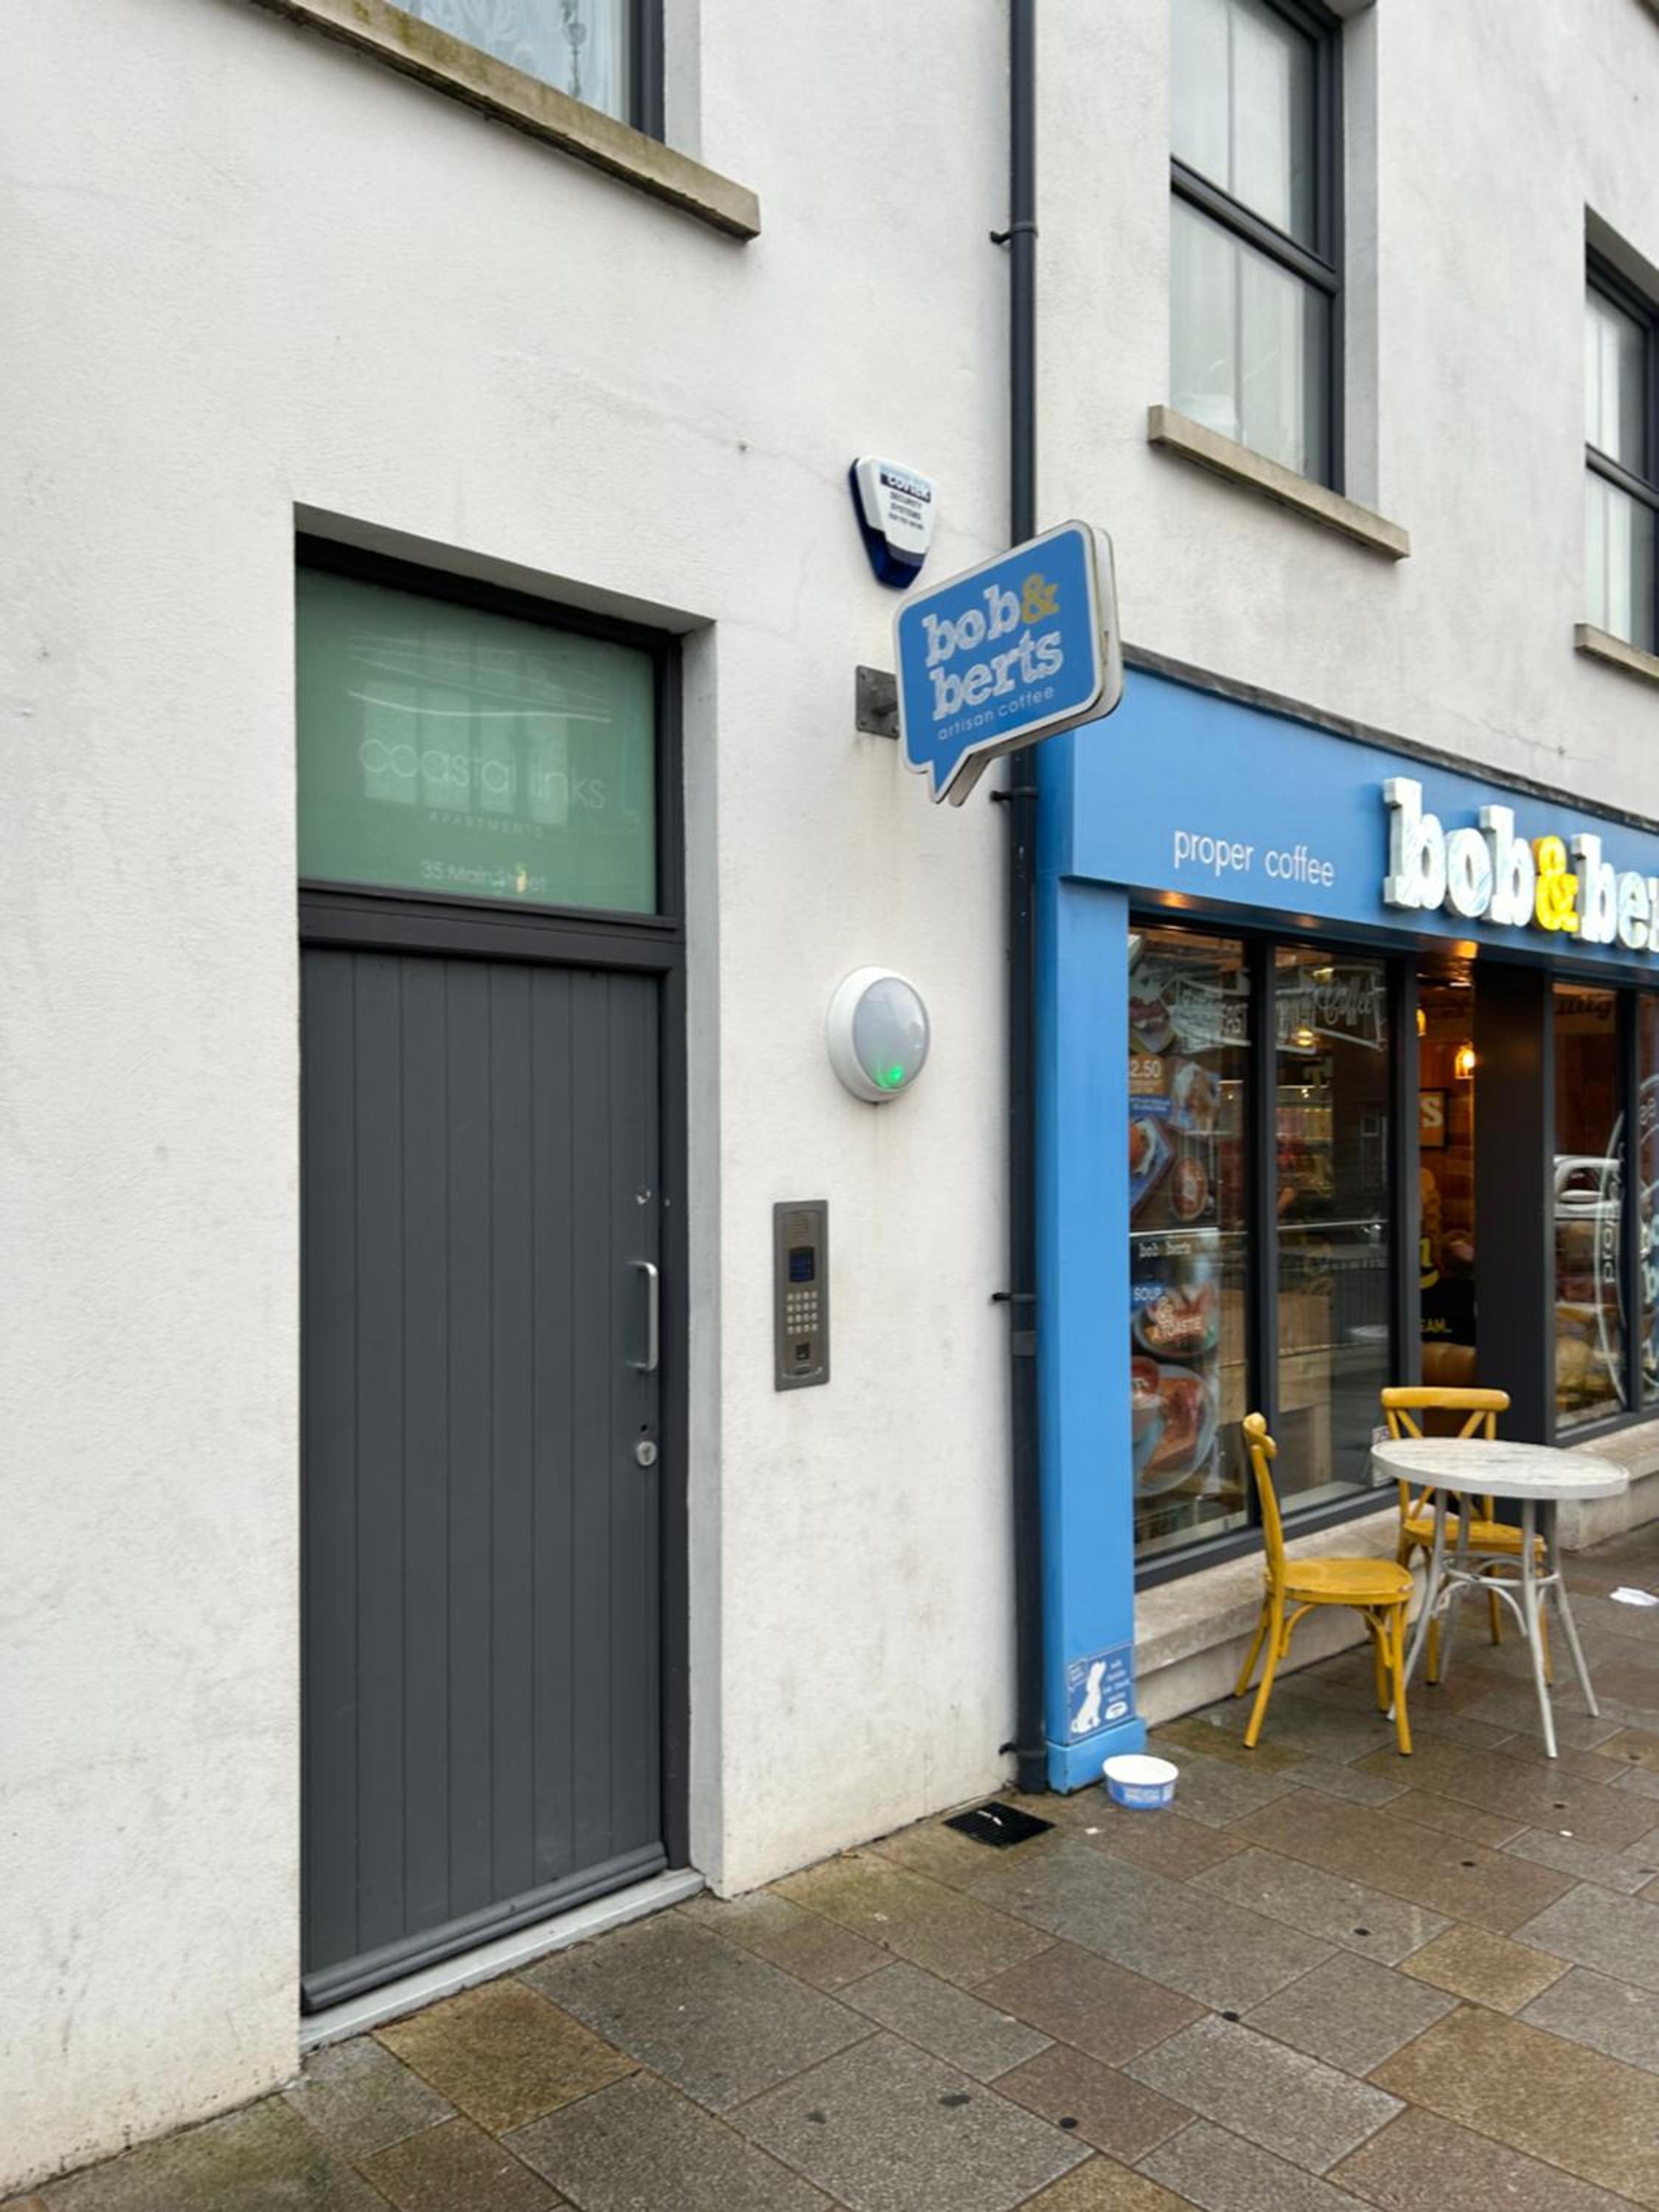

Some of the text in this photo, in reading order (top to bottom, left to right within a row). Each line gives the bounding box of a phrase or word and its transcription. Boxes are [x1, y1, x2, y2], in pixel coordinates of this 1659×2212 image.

[929, 629, 1064, 722] berts
[937, 686, 1055, 740] artisan coffee
[491, 867, 547, 892] Stet
[1173, 830, 1335, 887] proper coffee
